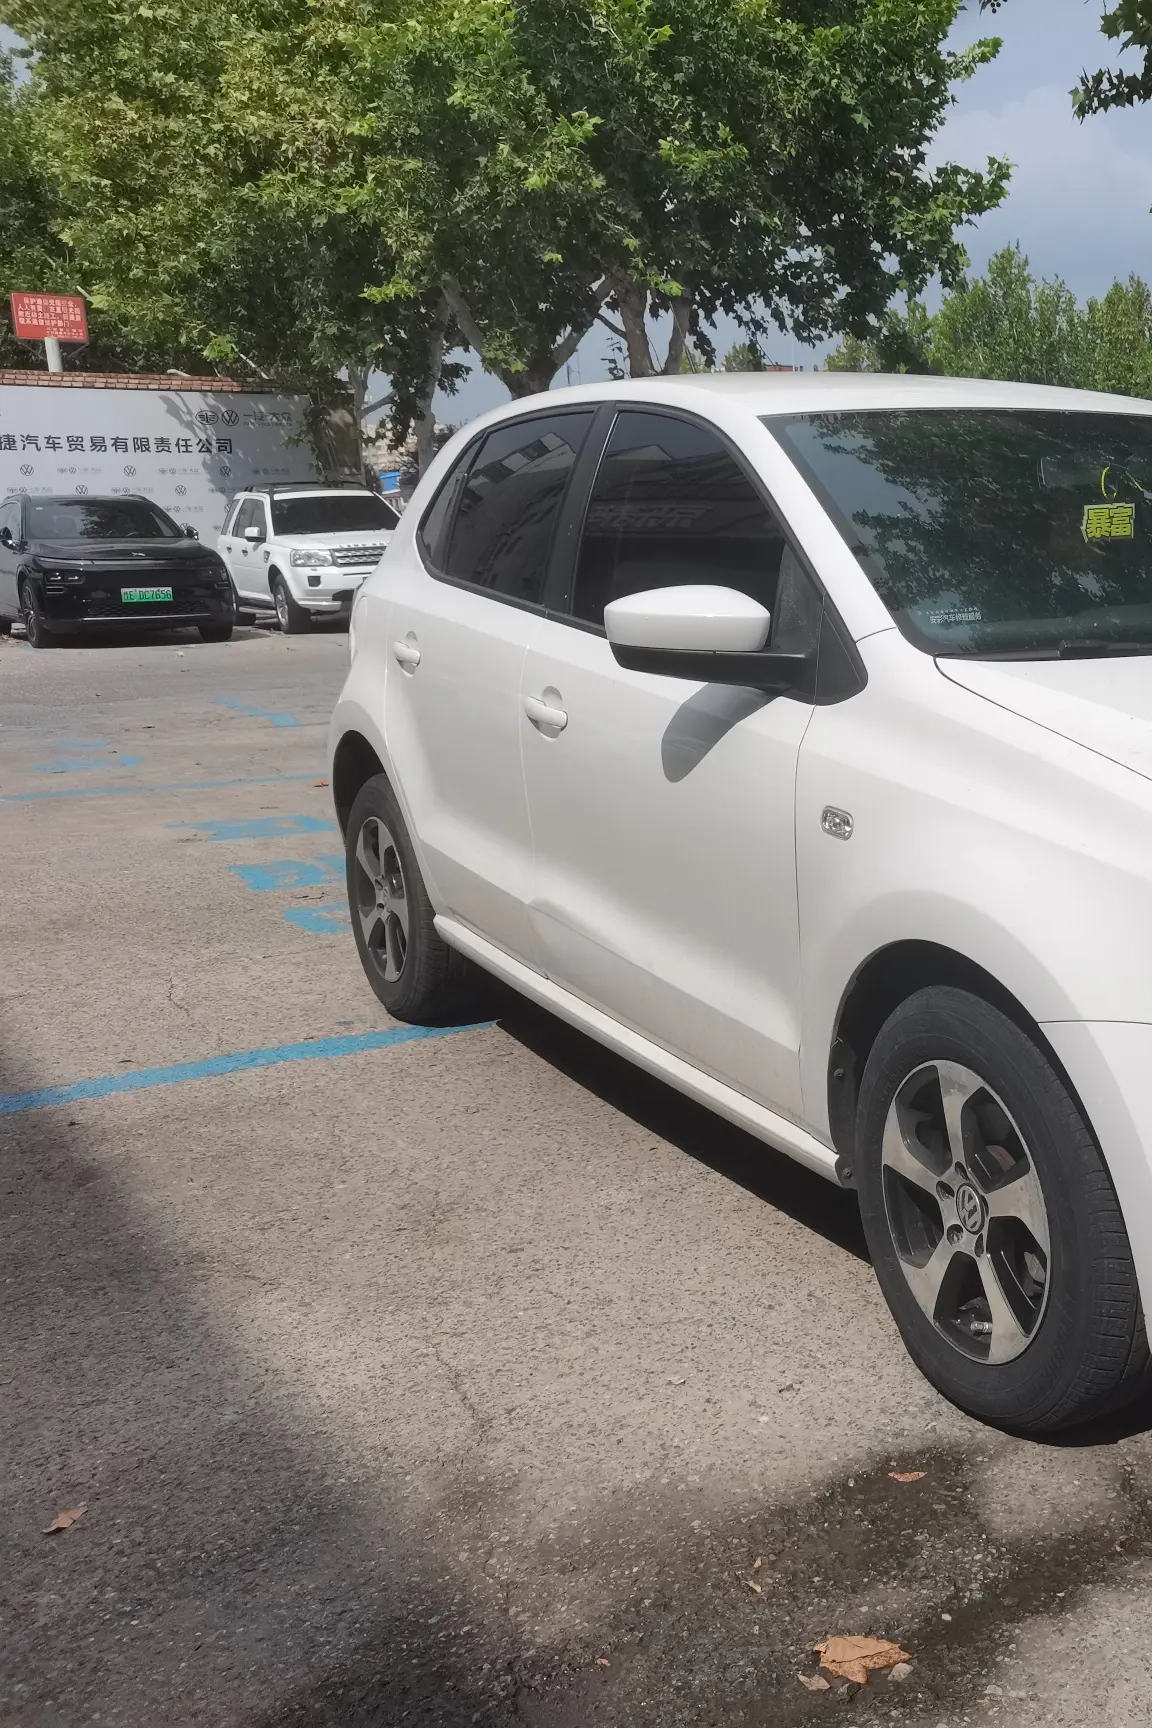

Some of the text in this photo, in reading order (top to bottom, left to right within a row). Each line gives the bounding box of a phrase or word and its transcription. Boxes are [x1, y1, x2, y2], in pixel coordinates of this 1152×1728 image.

[0, 434, 232, 455] 捷汽车贸易有限责任公司
[1087, 507, 1132, 539] 暴富
